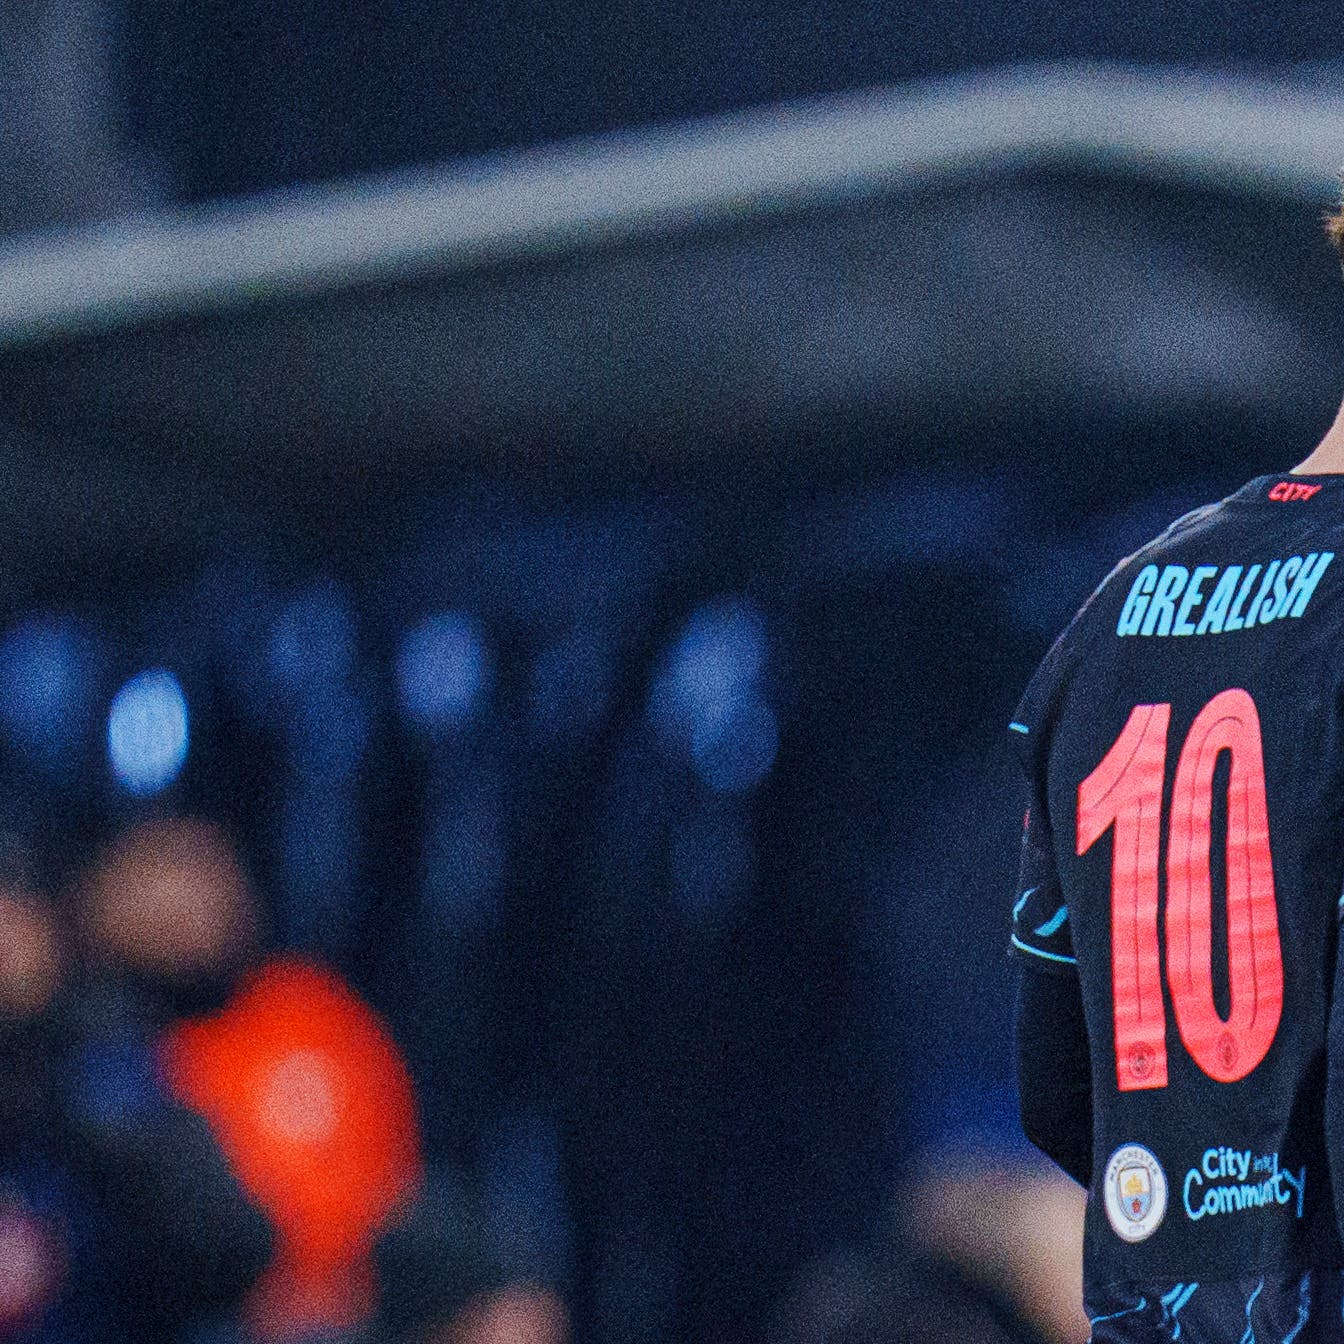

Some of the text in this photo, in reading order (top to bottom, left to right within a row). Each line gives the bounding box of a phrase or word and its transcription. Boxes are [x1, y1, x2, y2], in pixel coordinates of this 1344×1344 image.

[1268, 481, 1323, 502] CITY
[1116, 551, 1335, 637] GREALISH
[1076, 688, 1285, 1092] 10
[1183, 1151, 1306, 1221] Communty
[1202, 1146, 1251, 1181] City
